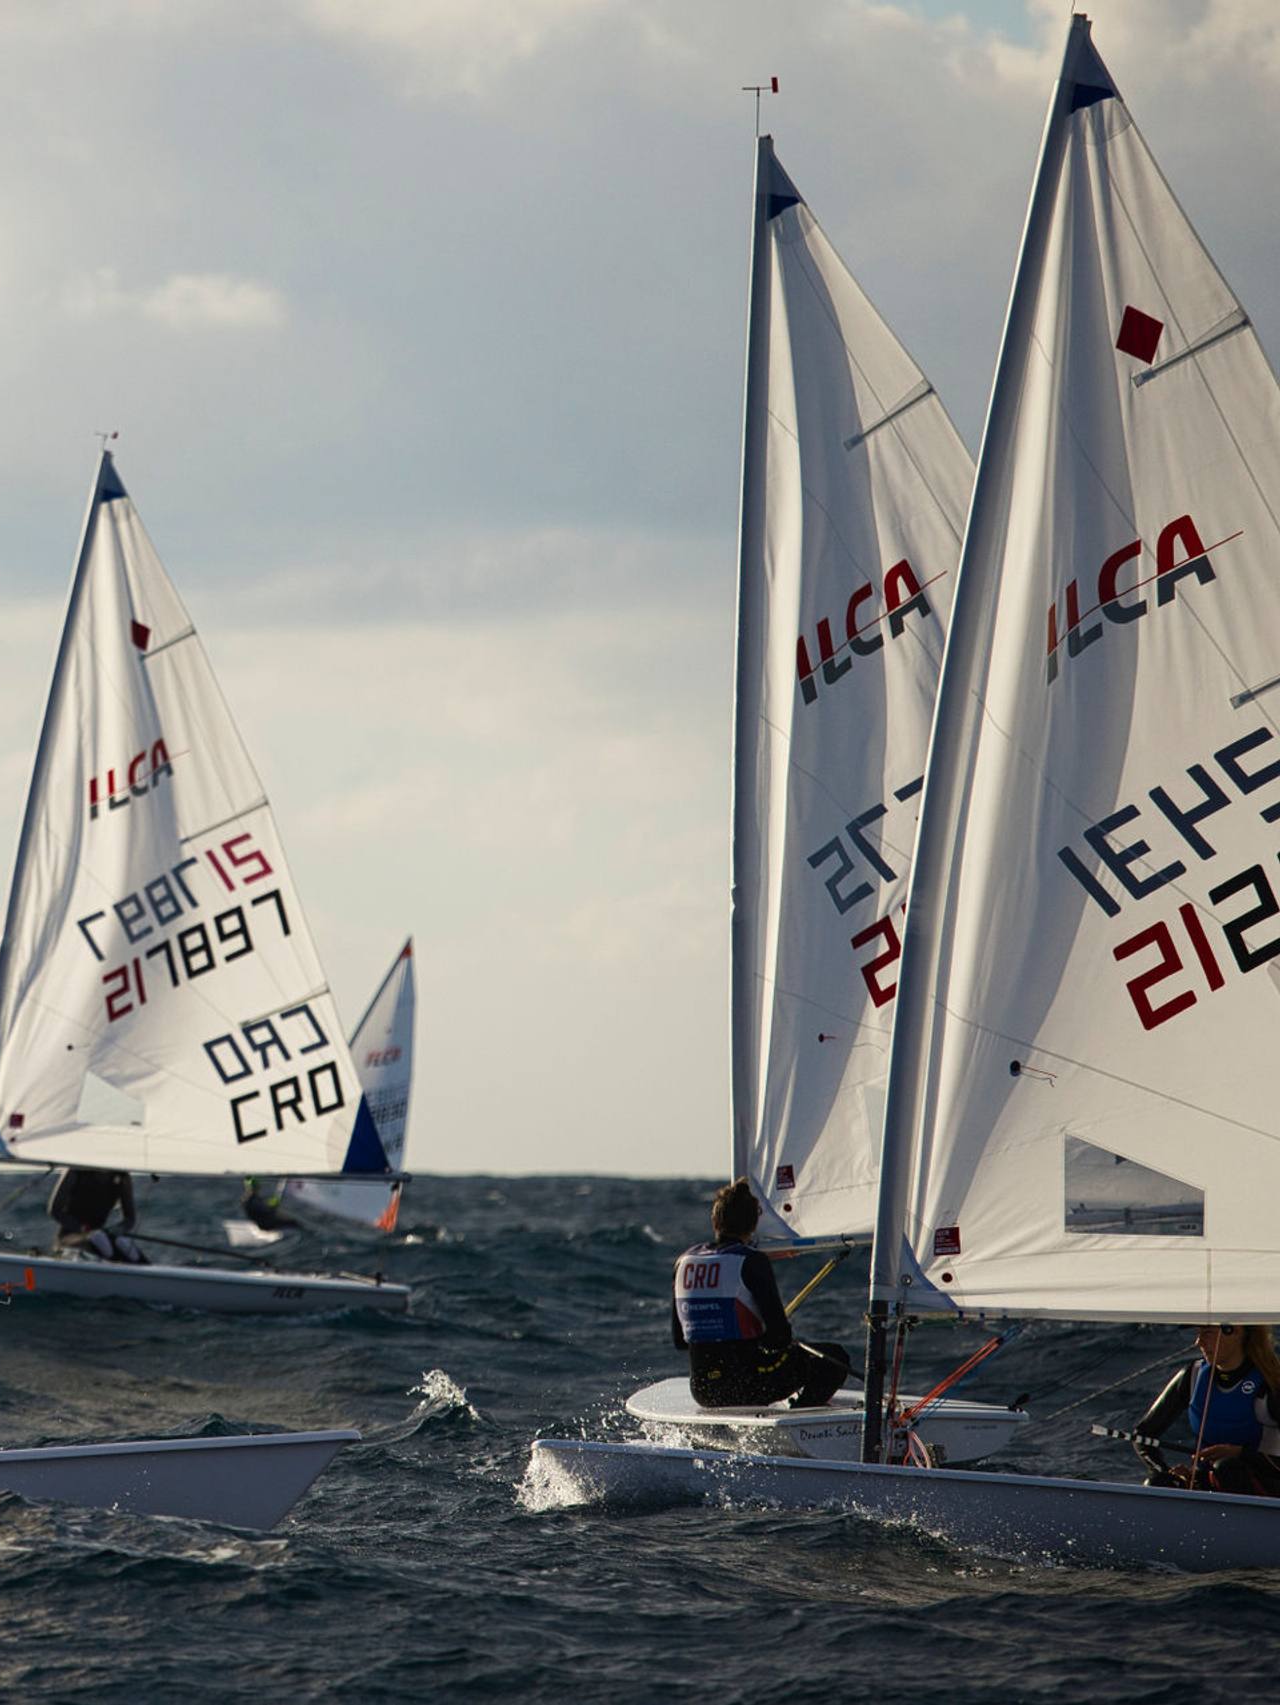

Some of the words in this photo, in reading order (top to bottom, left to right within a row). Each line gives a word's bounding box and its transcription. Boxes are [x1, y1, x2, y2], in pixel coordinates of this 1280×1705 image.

[796, 558, 932, 706] ILCA
[1048, 514, 1217, 686] ILCA
[89, 738, 173, 821] ILCA
[102, 889, 292, 1023] 217897
[851, 903, 907, 1008] 2
[1112, 851, 1280, 1032] 212
[231, 1060, 346, 1145] CRO
[683, 1263, 720, 1290] CRO
[836, 1424, 862, 1438] Sail
